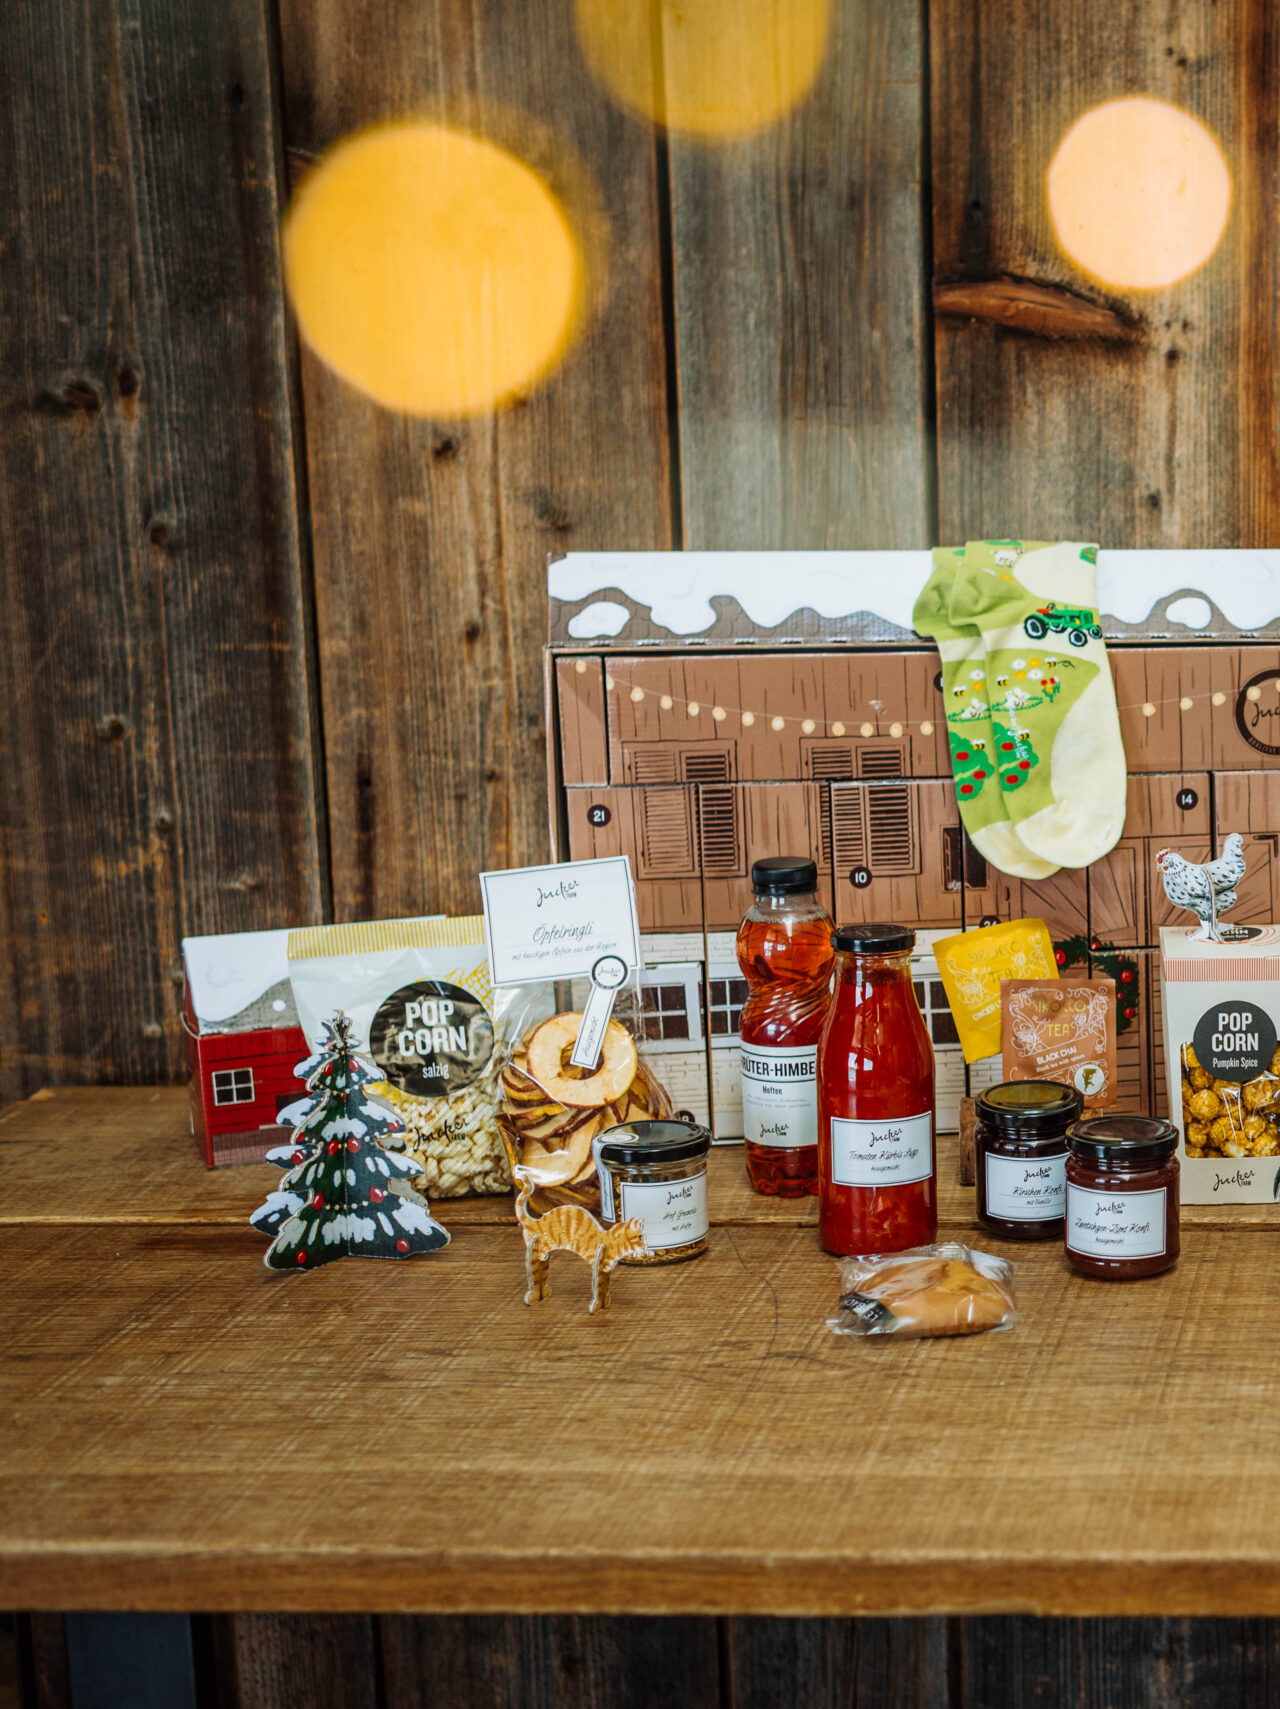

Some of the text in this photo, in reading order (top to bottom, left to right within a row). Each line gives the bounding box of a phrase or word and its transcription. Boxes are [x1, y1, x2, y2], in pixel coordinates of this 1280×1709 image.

[1181, 794, 1192, 805] 14
[593, 810, 605, 823] 21
[855, 871, 867, 884] 10
[537, 879, 580, 907] Jucker
[405, 1000, 454, 1028] POP
[1218, 1012, 1253, 1032] POP
[1047, 1023, 1070, 1037] TEA
[399, 1026, 467, 1056] CORN
[1211, 1032, 1259, 1052] CORN
[1036, 1046, 1077, 1065] BLACK CHAI
[1212, 1057, 1258, 1070] Pumpkin Spice
[422, 1062, 450, 1080] salzig
[741, 1056, 816, 1077] RÜTER-HIMBE
[763, 1086, 782, 1095] Hoftee
[413, 1118, 470, 1152] Jucker
[760, 1123, 789, 1137] Jucker
[869, 1128, 903, 1147] Jucker
[849, 1150, 877, 1160] Tomaten
[1024, 1166, 1052, 1182] Jucker
[1213, 1170, 1255, 1191] Jucker
[667, 1185, 693, 1205] Jucker
[1095, 1201, 1126, 1215] Jucker
